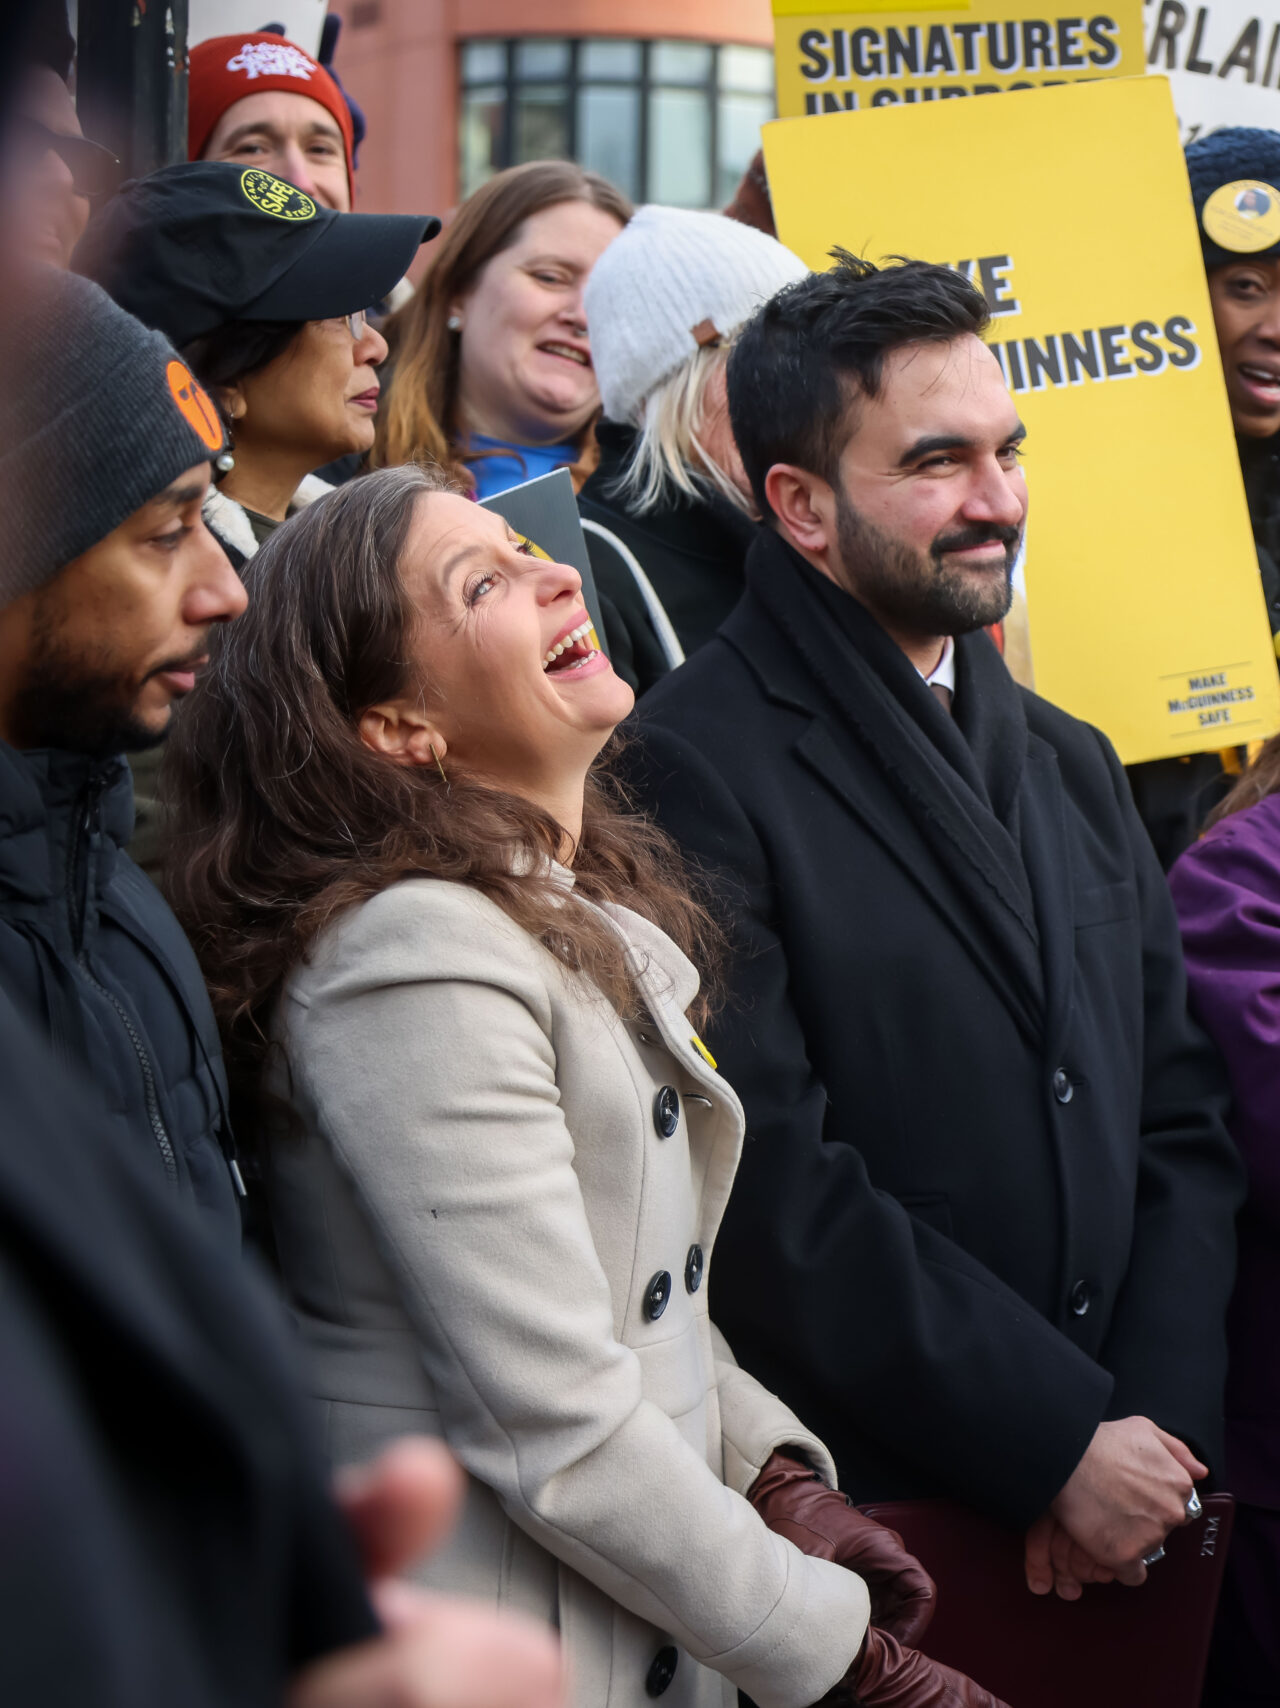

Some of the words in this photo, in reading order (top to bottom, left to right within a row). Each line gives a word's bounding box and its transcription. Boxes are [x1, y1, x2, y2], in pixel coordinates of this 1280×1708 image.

[798, 14, 1122, 83] SIGNATURES
[261, 180, 294, 213] SAFE
[1188, 672, 1227, 691] MAKE
[1198, 708, 1232, 727] SAFE
